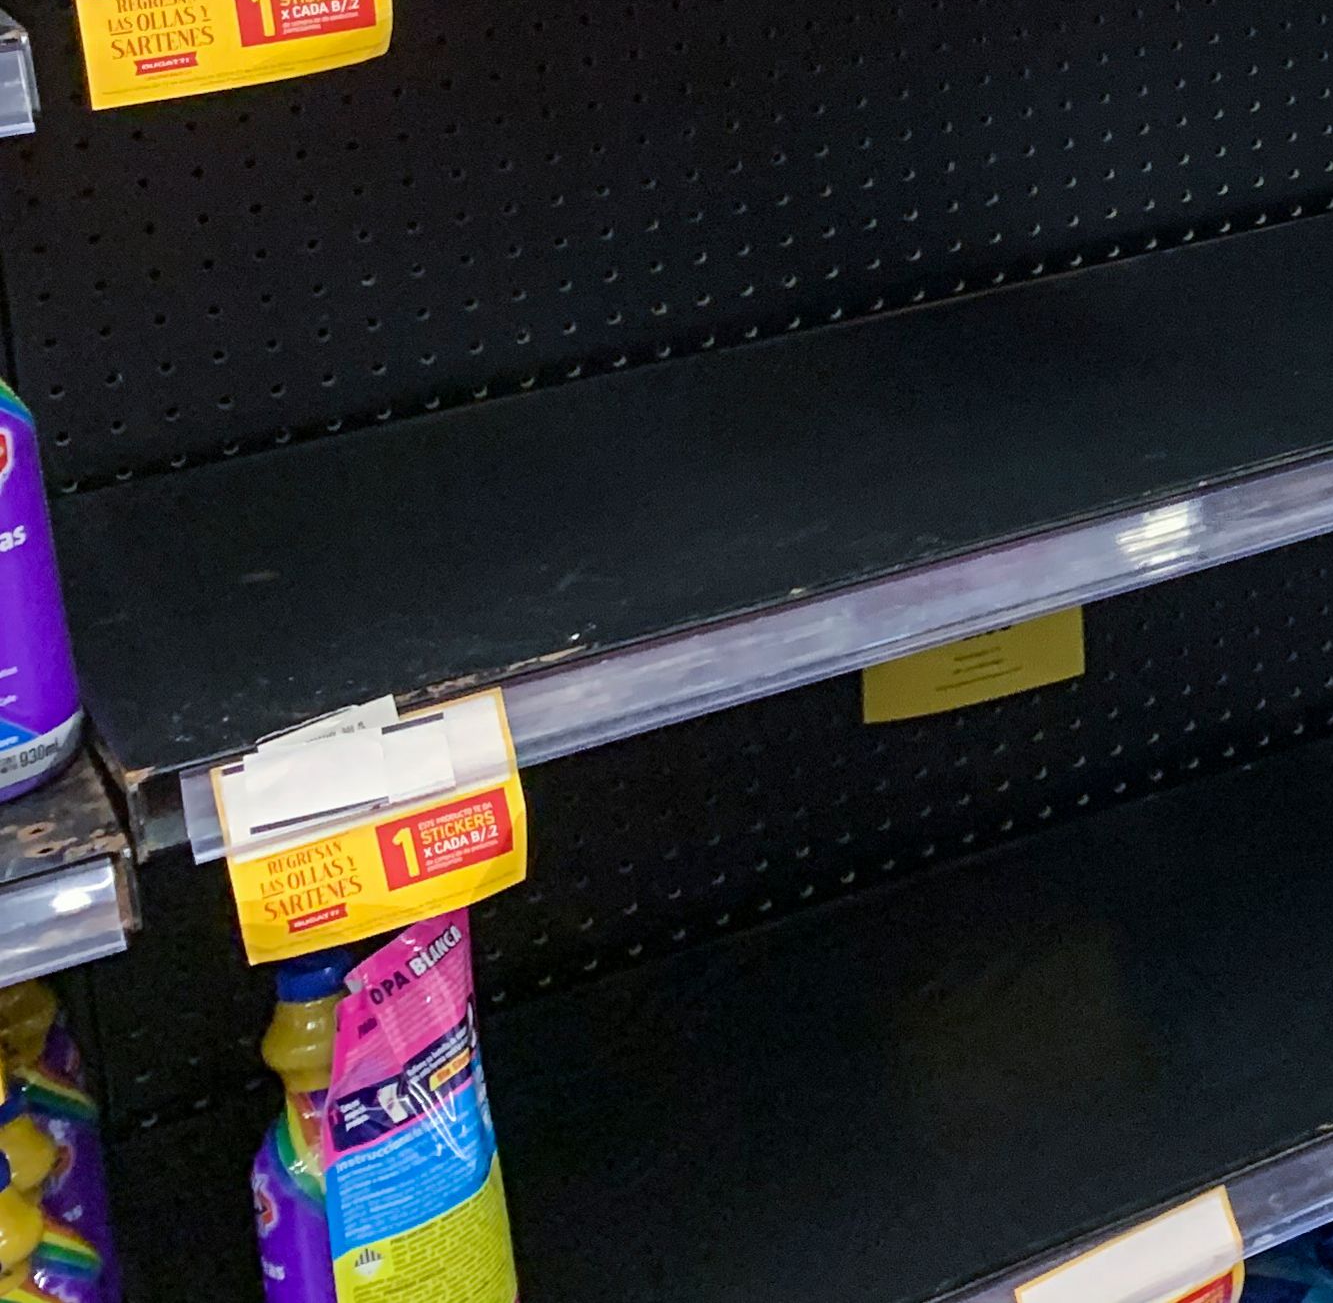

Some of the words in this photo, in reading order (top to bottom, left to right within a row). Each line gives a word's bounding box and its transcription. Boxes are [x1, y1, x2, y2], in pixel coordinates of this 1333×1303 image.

[107, 17, 133, 36] LAS
[136, 7, 196, 32] OLLAS
[280, 10, 290, 20] x
[292, 2, 328, 19] CADA
[111, 26, 215, 60] SARTENES
[420, 810, 497, 846] STICKERS
[267, 840, 343, 876] REGRESAN
[391, 826, 421, 878] 1
[423, 847, 433, 859] x
[433, 834, 469, 855] CADA
[259, 880, 285, 898] LAS
[287, 859, 344, 890] OLLAS
[264, 874, 364, 923] SARTENES
[408, 925, 462, 978] BLANCA
